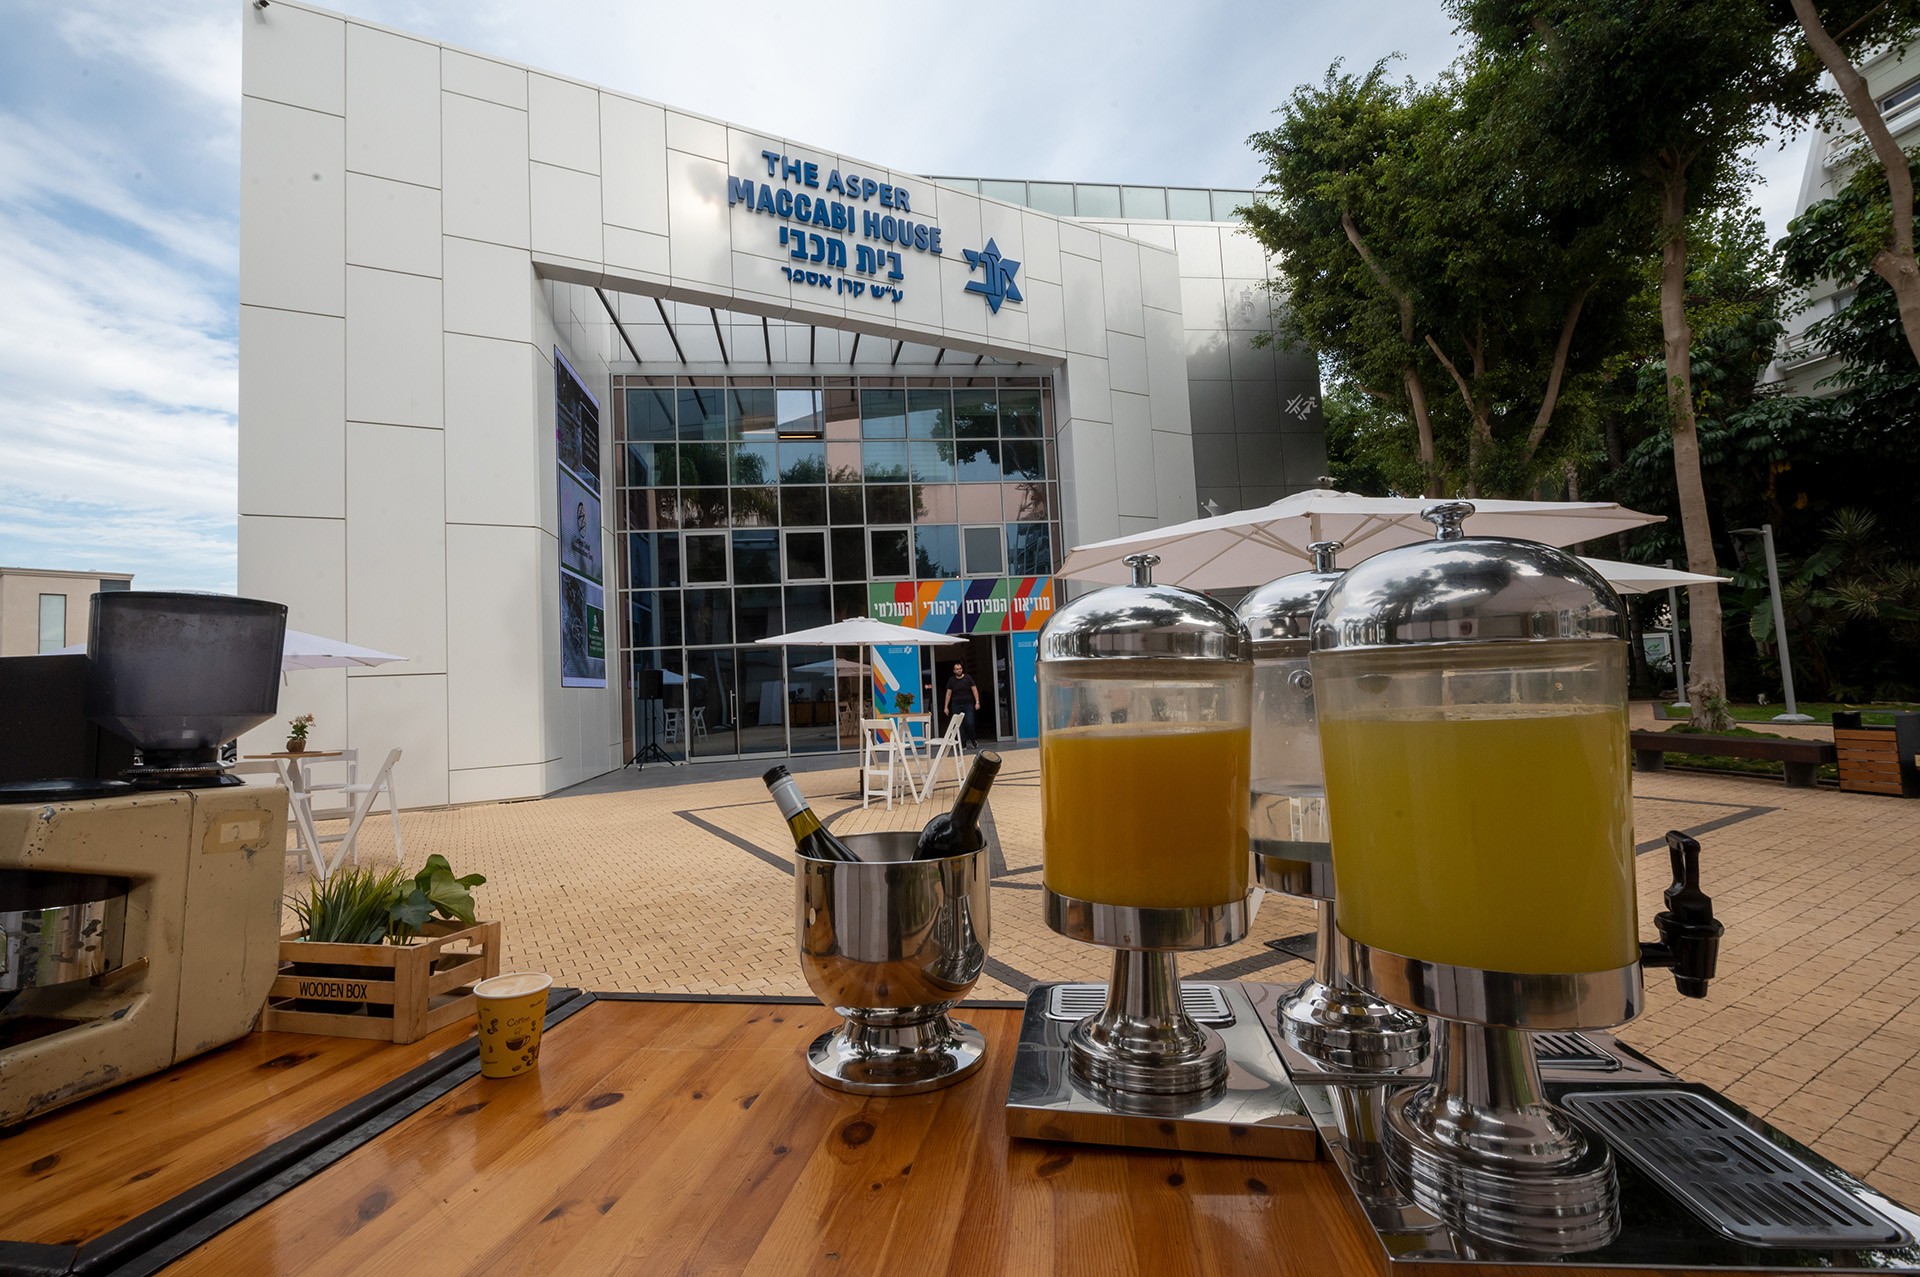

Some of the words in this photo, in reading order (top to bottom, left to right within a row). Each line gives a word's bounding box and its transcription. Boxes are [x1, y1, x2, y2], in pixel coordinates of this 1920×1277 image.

[761, 150, 819, 188] THE
[826, 169, 911, 212] ASPER
[728, 175, 856, 233] MACCABI
[863, 209, 943, 254] HOUSE
[778, 225, 848, 268] מכבי
[855, 243, 905, 280] בית
[780, 266, 832, 289] אספר
[836, 277, 866, 298] קרן
[873, 601, 913, 618] העולמי
[922, 600, 958, 616] היהודי
[965, 598, 1008, 615] הספורט
[1013, 596, 1051, 613] מוזיאון
[299, 981, 344, 998] WOODEN
[346, 983, 368, 999] BOX
[506, 1016, 530, 1028] Coffee
